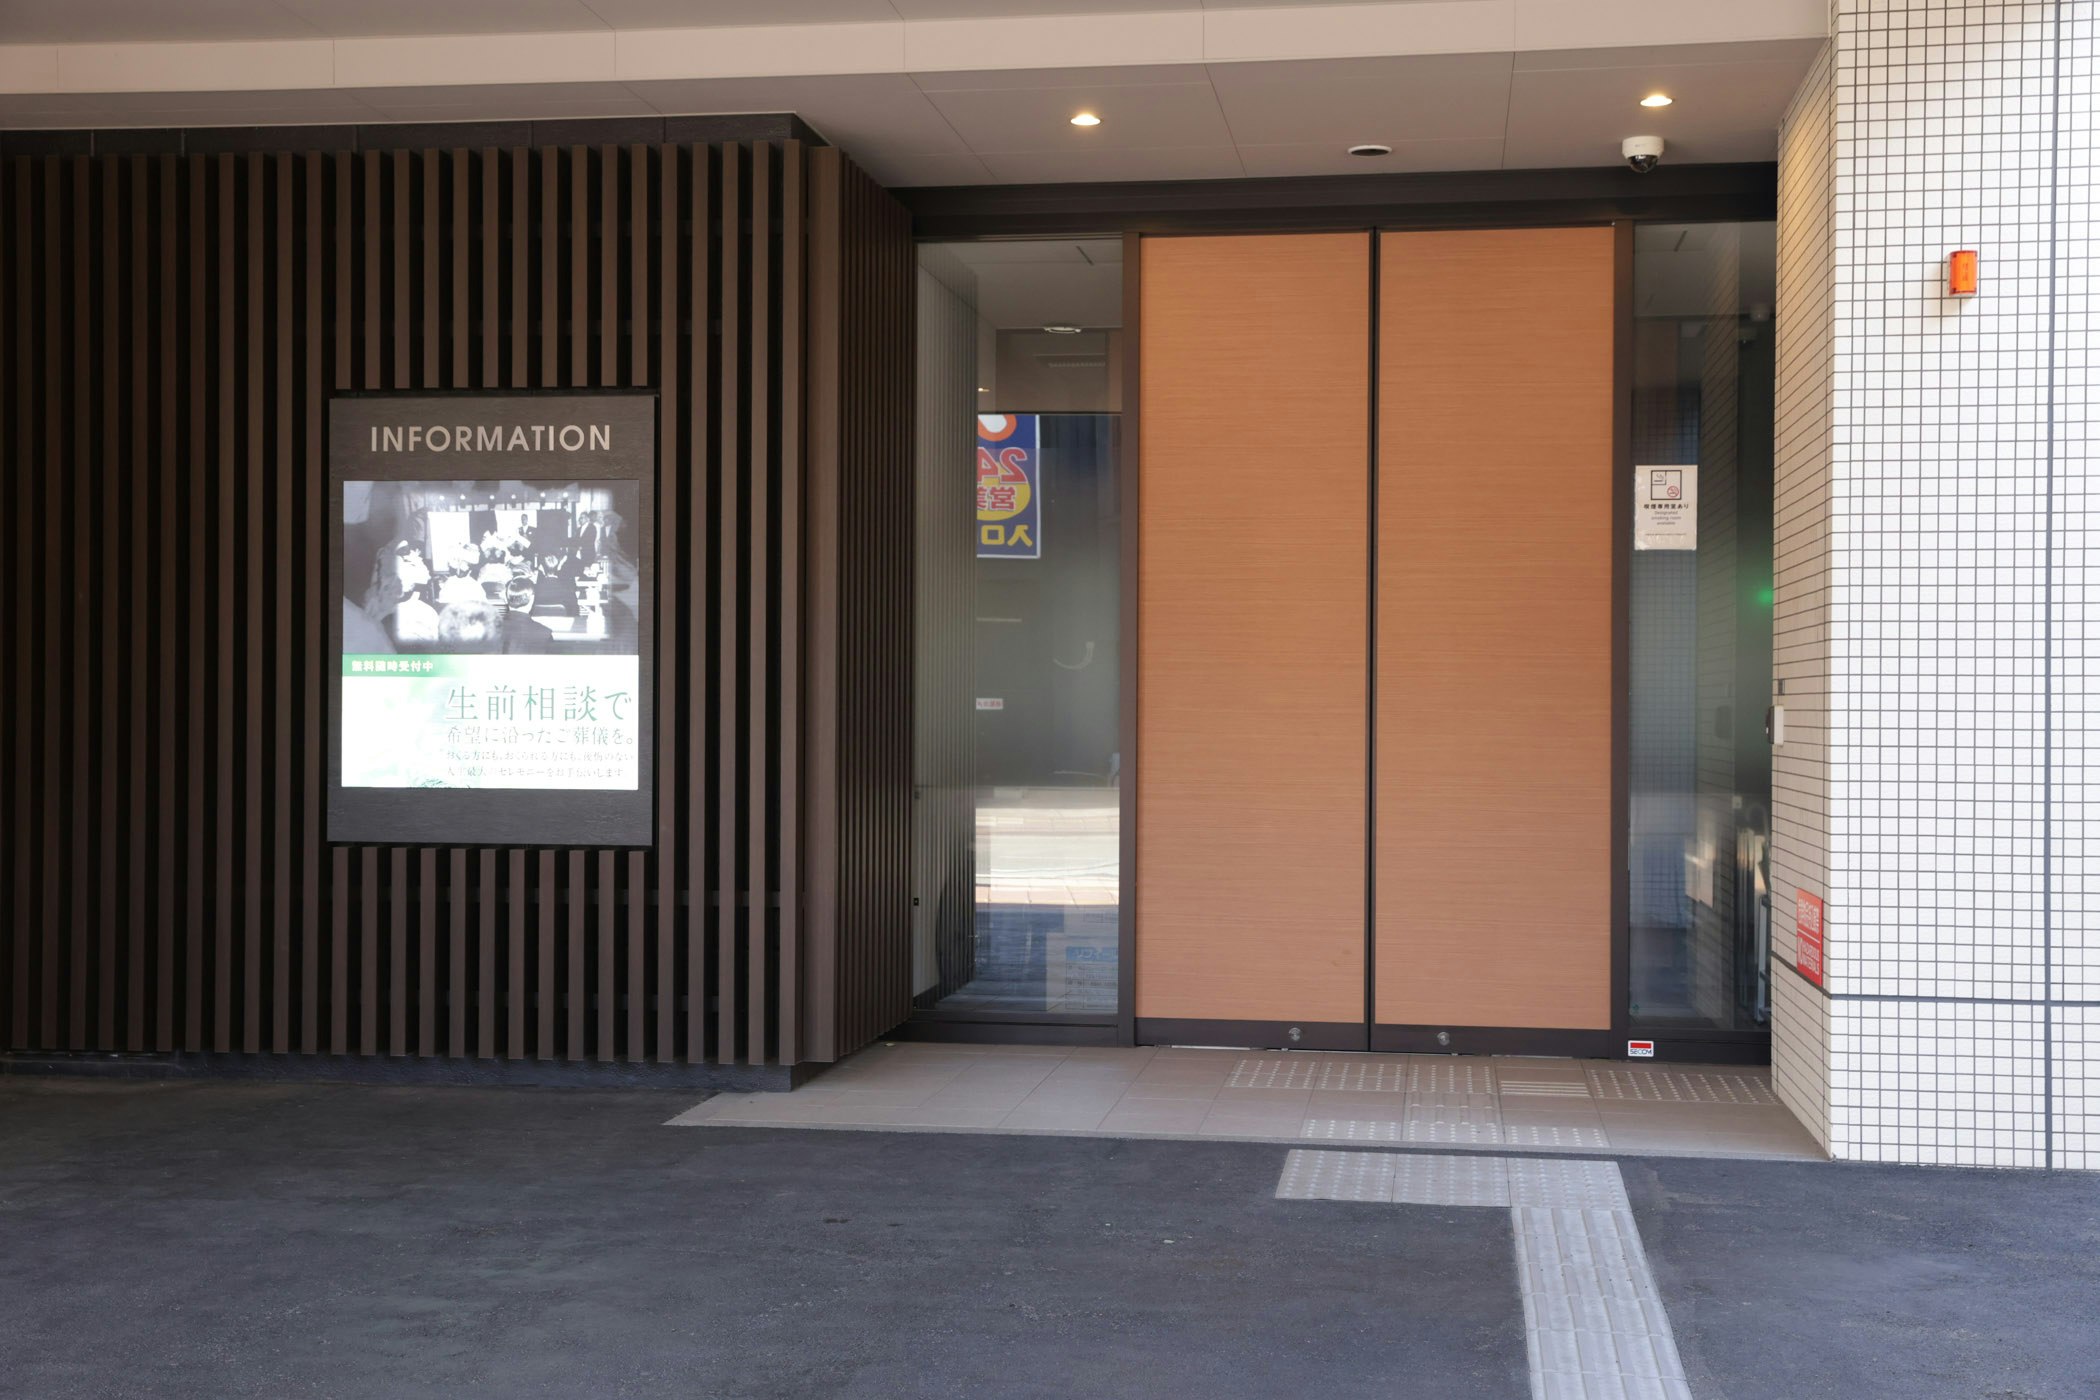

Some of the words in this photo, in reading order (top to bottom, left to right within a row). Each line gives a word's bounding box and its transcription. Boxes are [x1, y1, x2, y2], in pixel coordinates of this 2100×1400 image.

[371, 424, 611, 452] INFORMATION
[446, 684, 633, 722] 生前相談で
[447, 725, 634, 746] 希望に沿ったご葬儀を。
